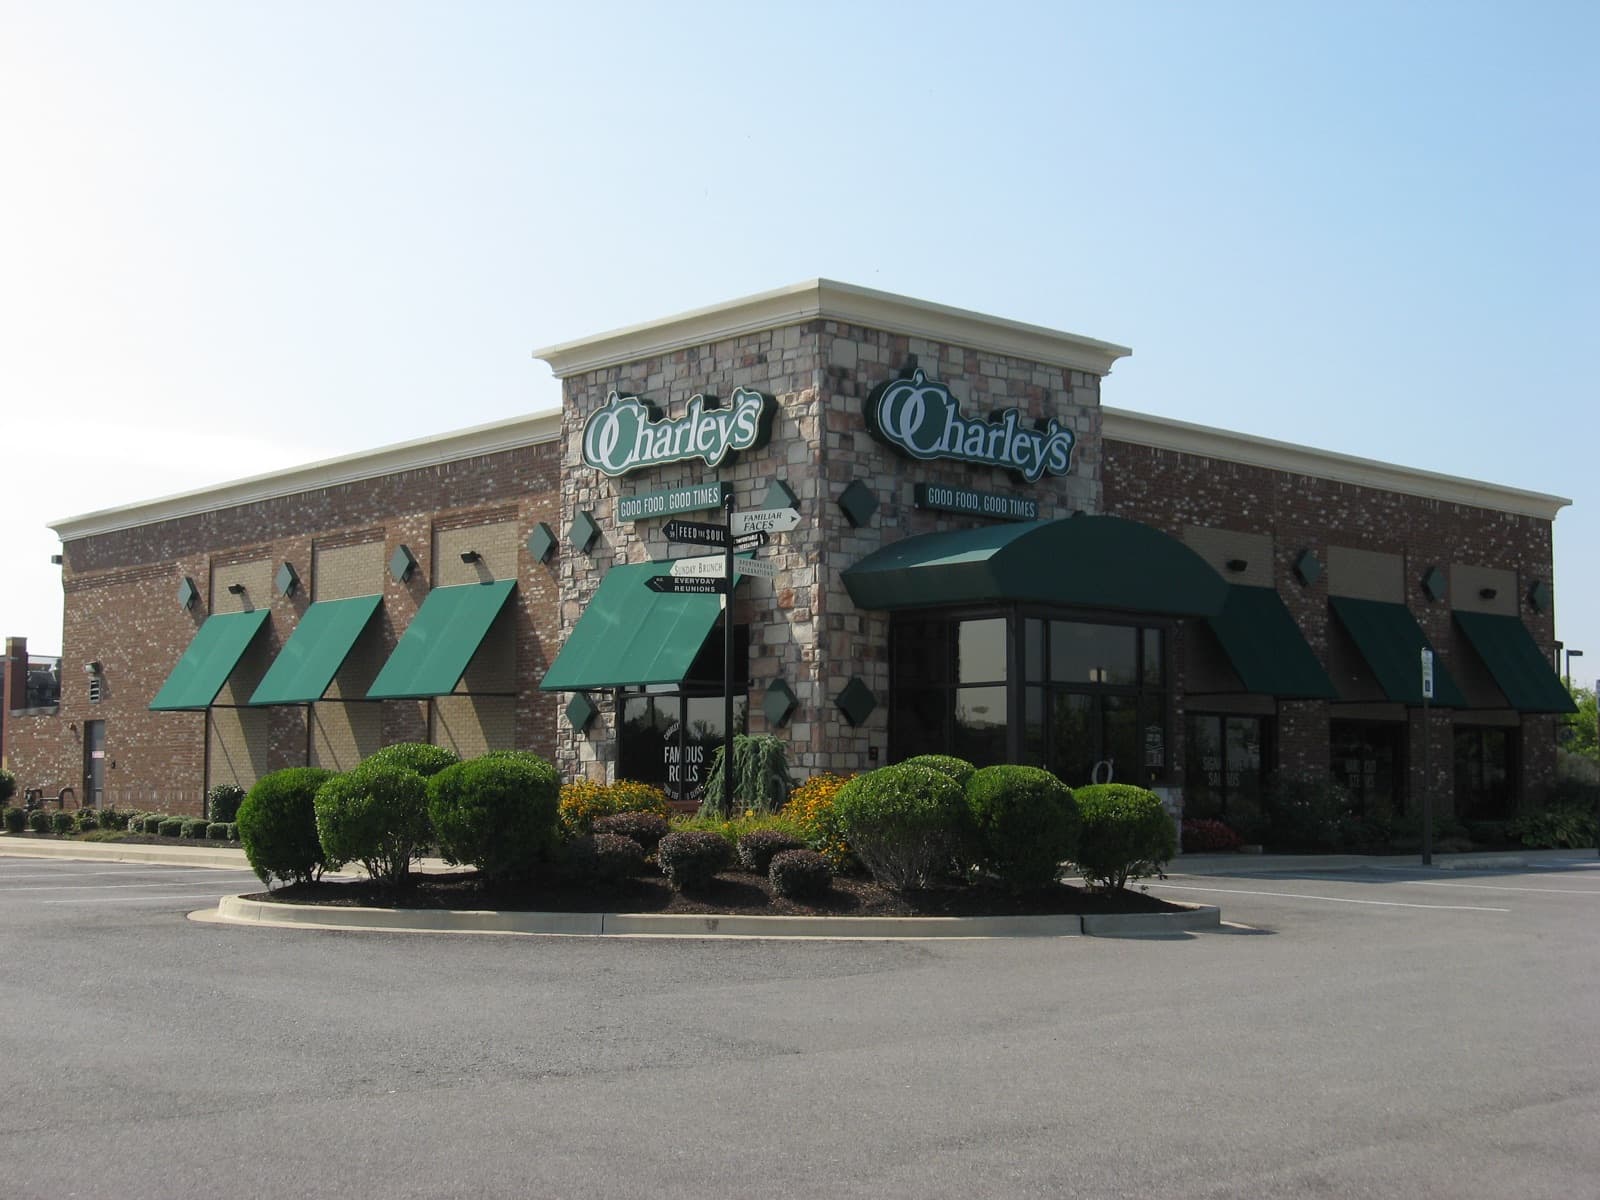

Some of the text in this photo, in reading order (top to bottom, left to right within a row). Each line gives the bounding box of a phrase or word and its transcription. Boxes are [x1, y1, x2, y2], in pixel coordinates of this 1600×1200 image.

[586, 393, 760, 470] O'Charley's
[882, 373, 1071, 477] O'Charley's
[620, 487, 719, 517] GOOD FOOD, GOOD TIMES
[928, 487, 1036, 518] GOOD FOOD, GOOD TIMES
[743, 511, 782, 522] FAMILIAR
[743, 520, 774, 532] FACES
[679, 527, 697, 539] FEED
[706, 529, 725, 542] SOUL
[698, 562, 723, 573] BRUNCH
[674, 585, 716, 593] REUNIONS
[669, 765, 699, 782] ROLS
